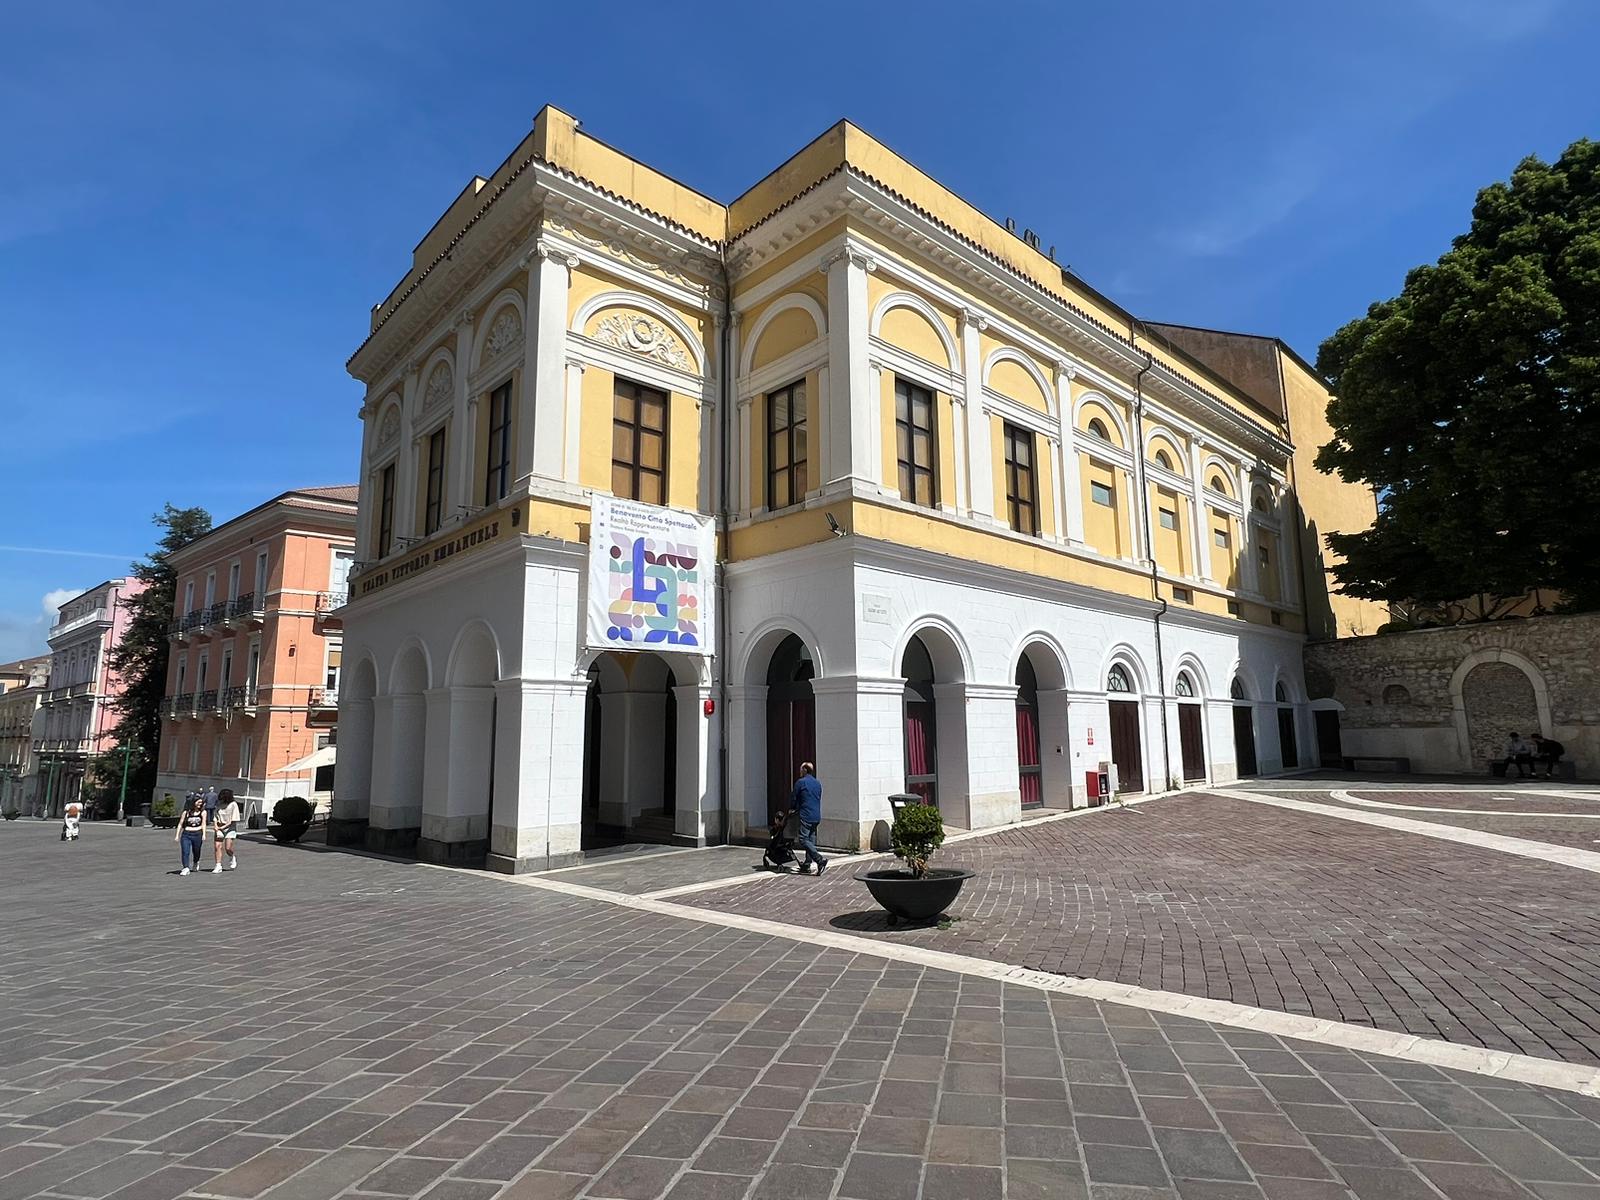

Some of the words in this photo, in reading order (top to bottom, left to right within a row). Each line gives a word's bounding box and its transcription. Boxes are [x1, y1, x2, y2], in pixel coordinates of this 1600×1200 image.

[610, 507, 646, 520] Benevento
[363, 572, 388, 593] TEATRO
[392, 553, 430, 580] VITTORIO
[433, 522, 499, 562] EMMANUELE
